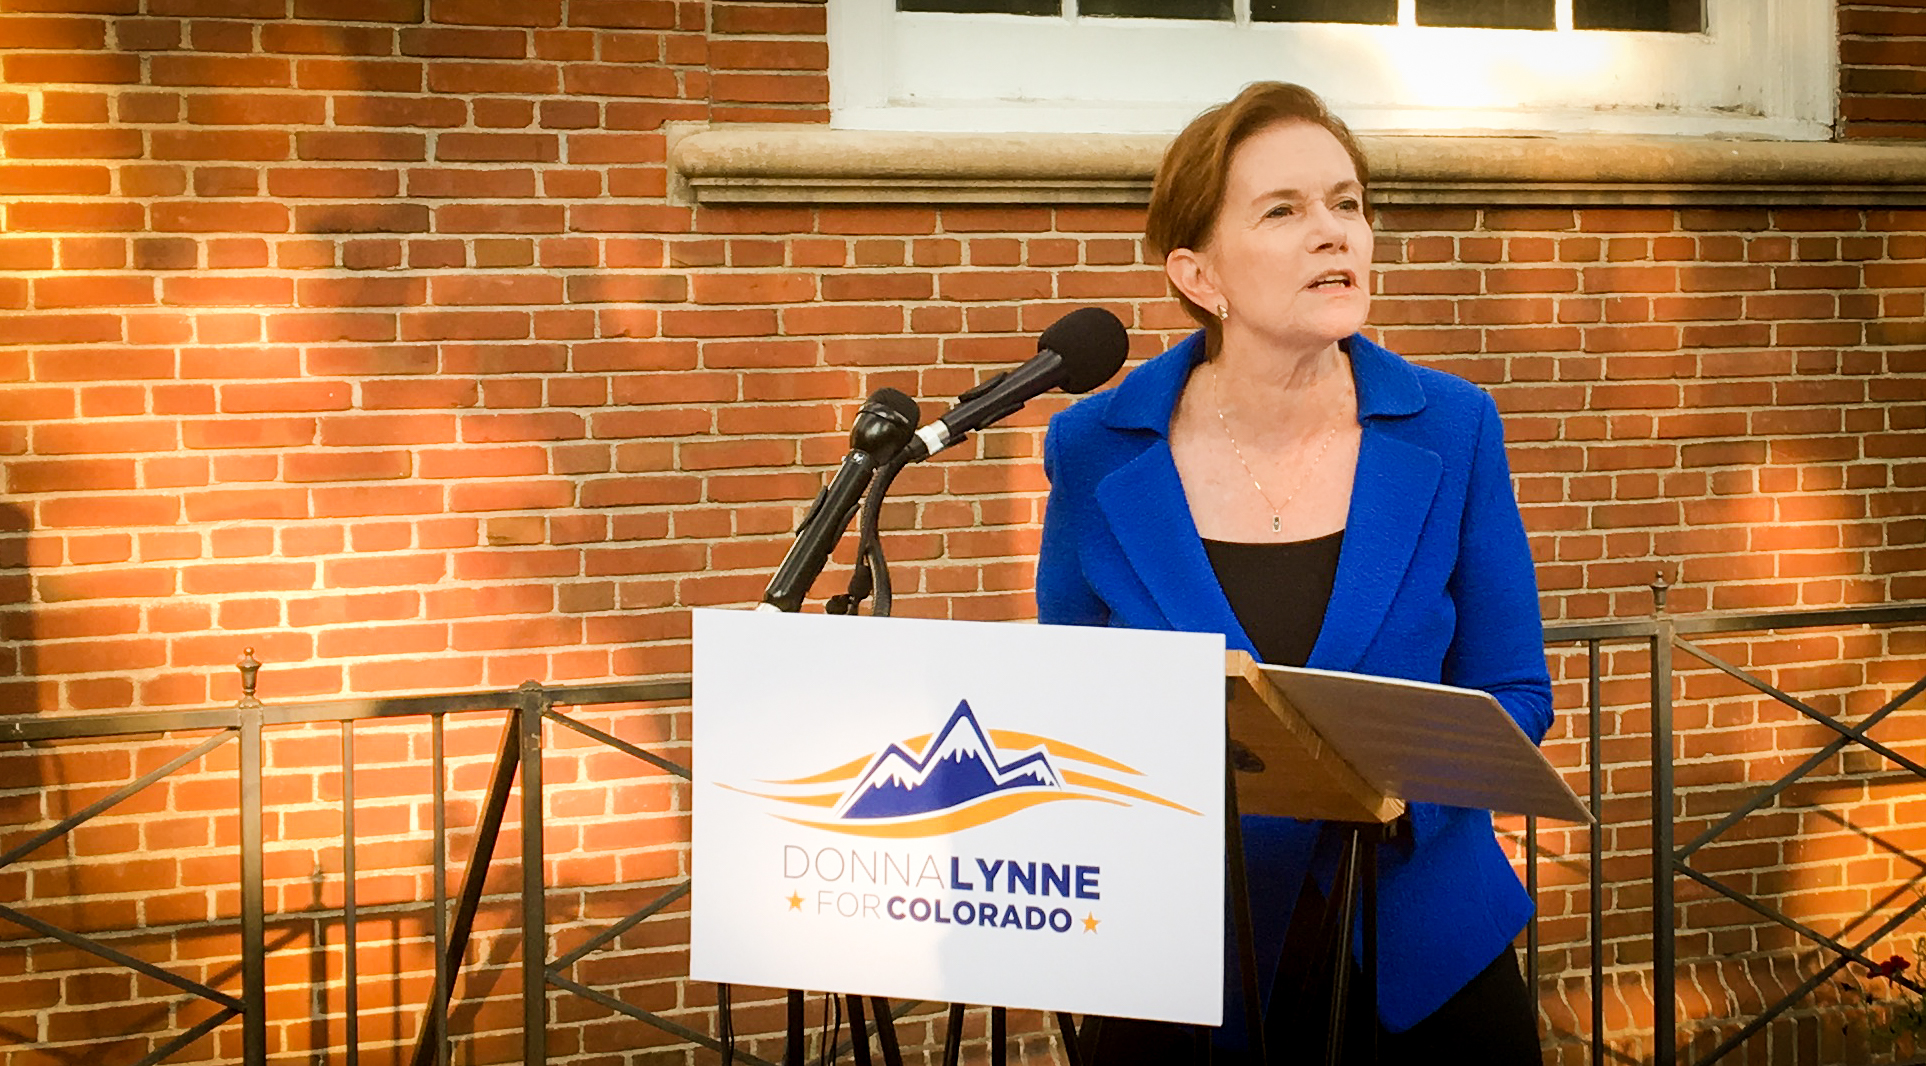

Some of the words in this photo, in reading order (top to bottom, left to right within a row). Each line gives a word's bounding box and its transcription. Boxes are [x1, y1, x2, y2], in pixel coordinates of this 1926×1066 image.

[784, 845, 945, 889] DONNA
[951, 856, 1100, 900] LYNNE
[817, 890, 880, 919] FOR
[887, 896, 1072, 933] COLORADO
